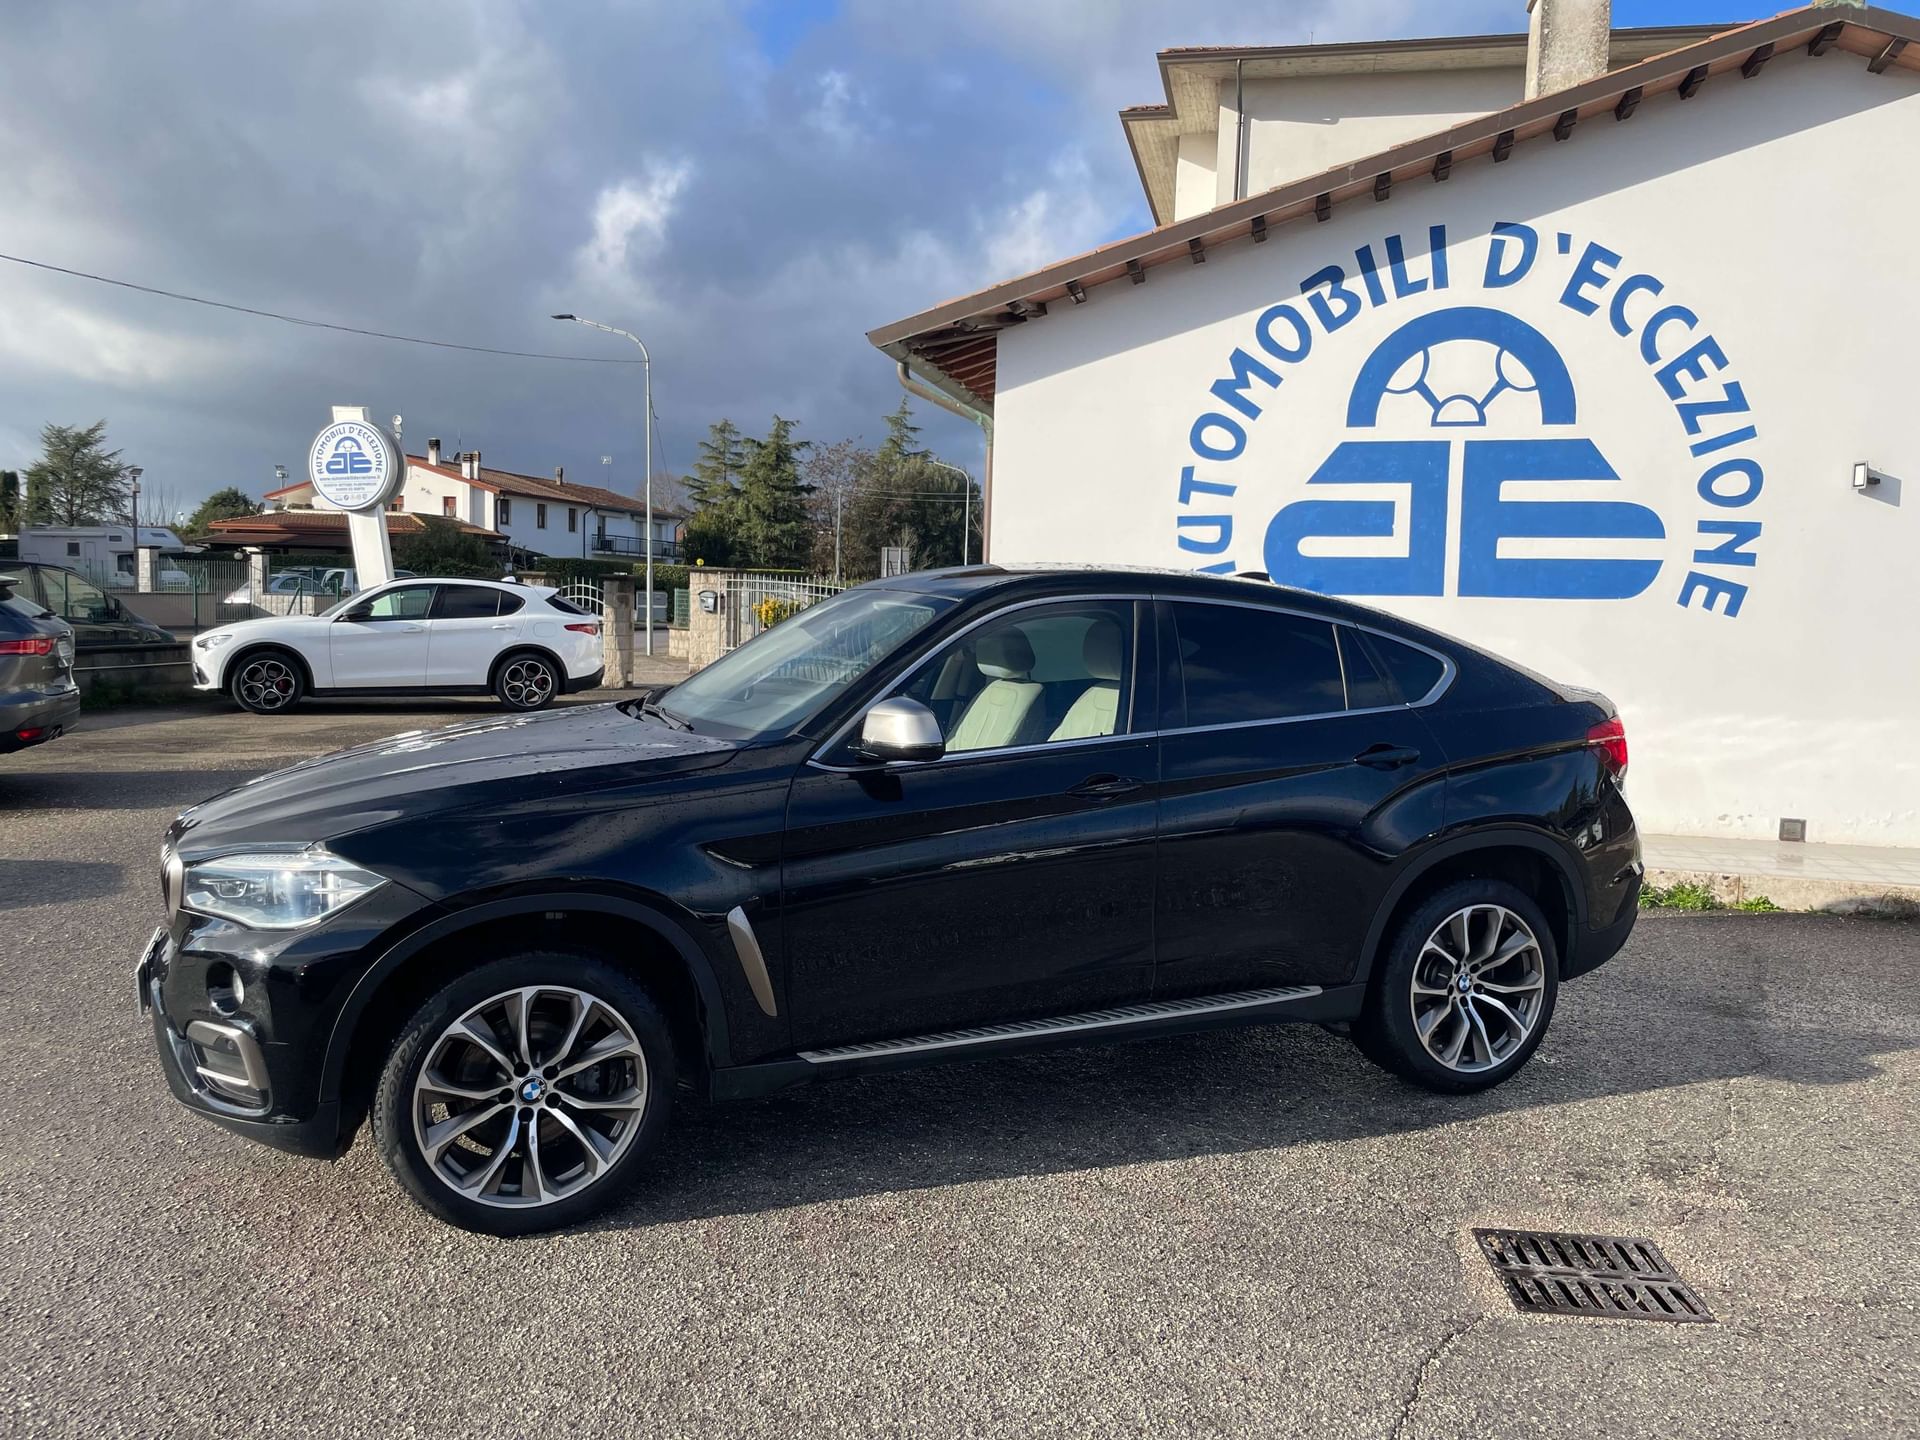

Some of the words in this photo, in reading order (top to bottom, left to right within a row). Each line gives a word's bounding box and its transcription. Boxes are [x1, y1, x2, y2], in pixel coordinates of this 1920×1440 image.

[316, 427, 346, 474] AUTOMOBILI
[348, 427, 382, 472] D'ECCEZIONE
[1483, 221, 1764, 618] D'ECCEZIONE
